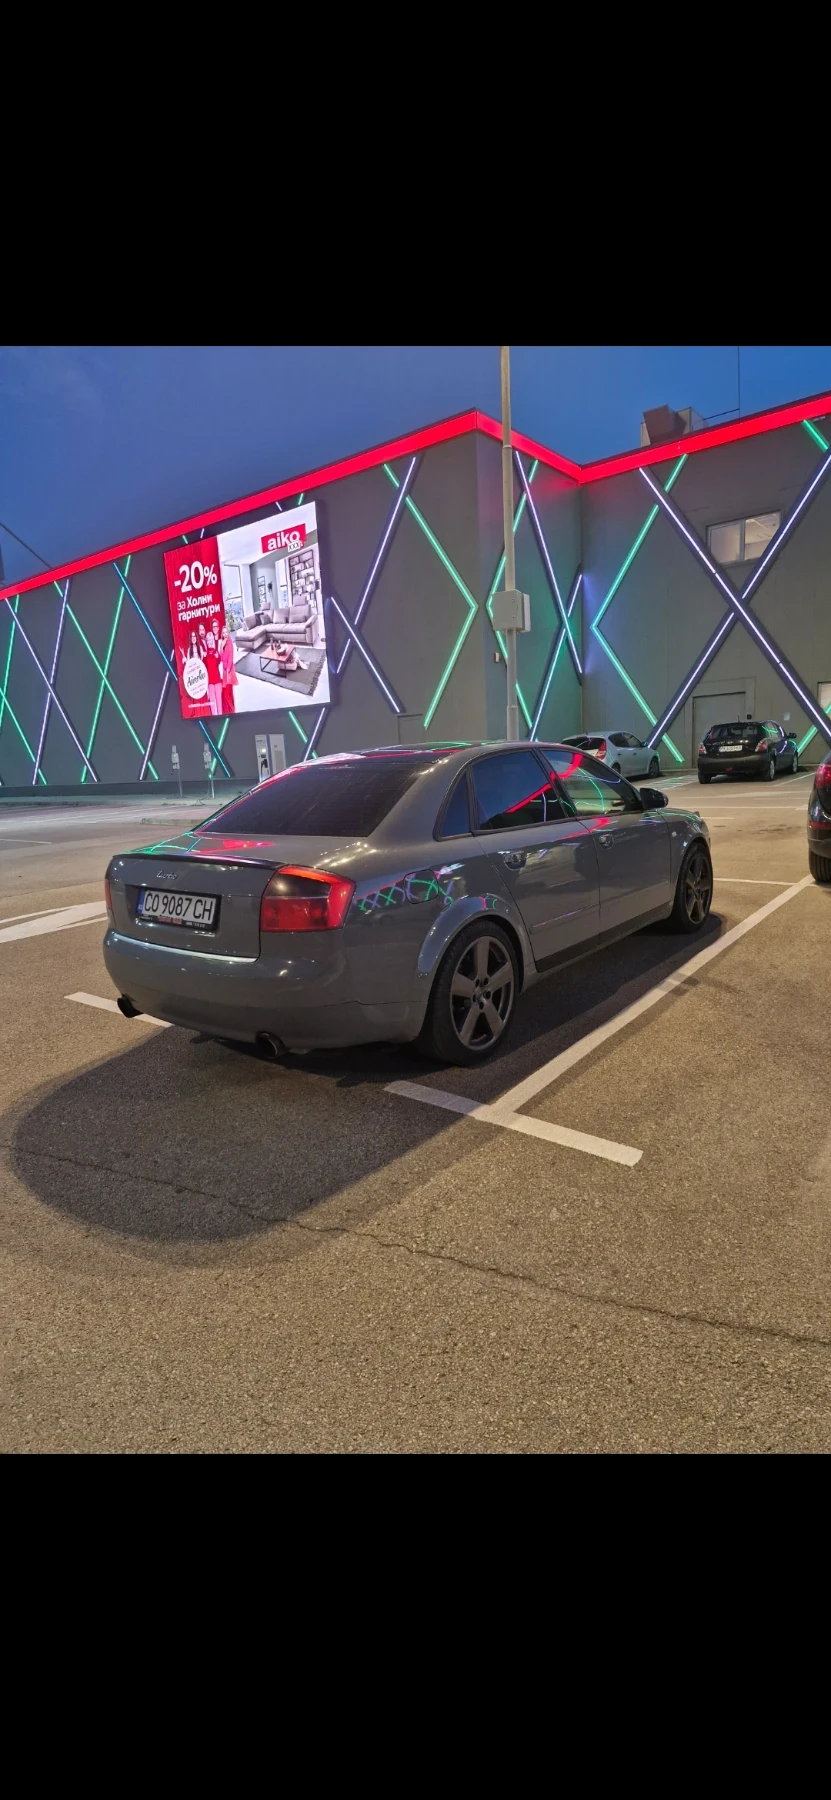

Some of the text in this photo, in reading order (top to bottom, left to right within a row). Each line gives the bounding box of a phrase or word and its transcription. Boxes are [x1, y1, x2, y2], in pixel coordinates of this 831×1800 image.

[267, 531, 300, 550] aiko
[174, 561, 217, 593] -20%
[177, 594, 212, 610] за Холни
[178, 604, 220, 622] гарнитури
[145, 893, 213, 920] CO 9087 CH
